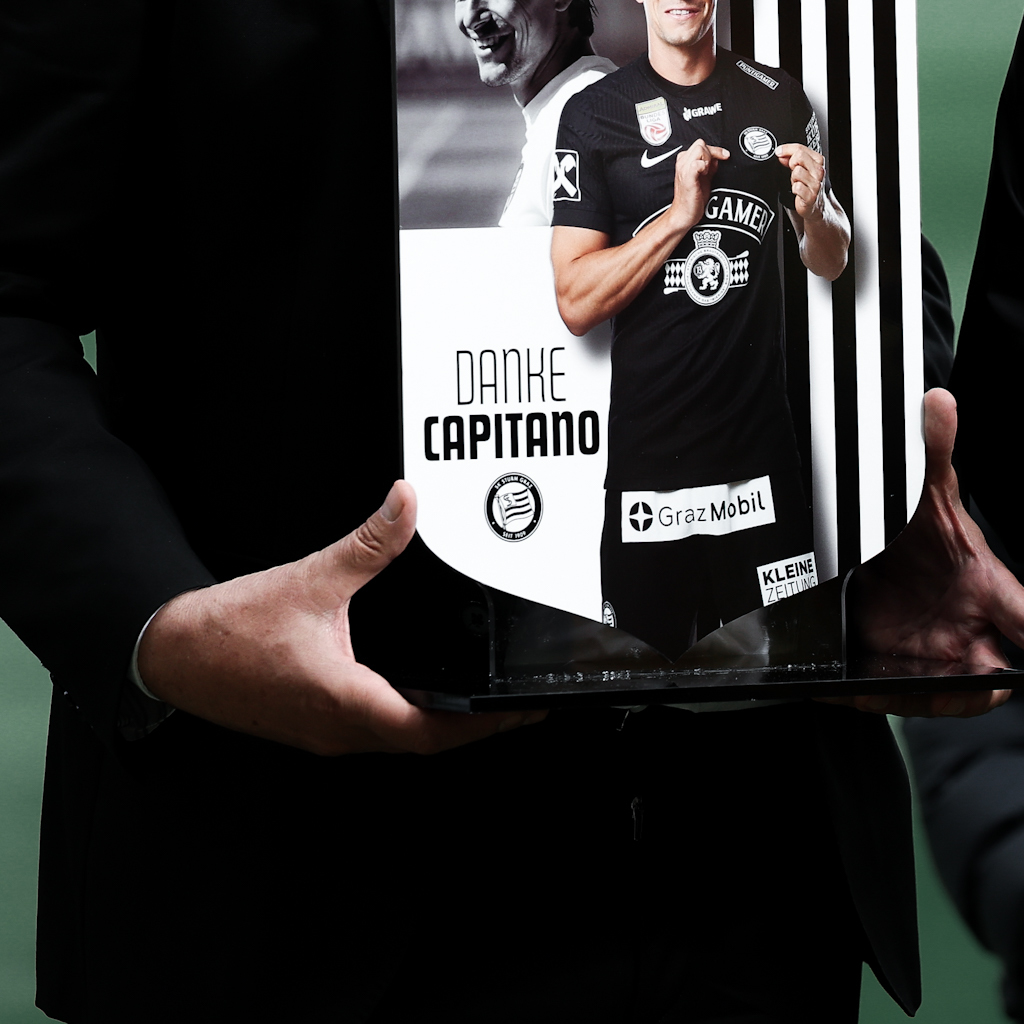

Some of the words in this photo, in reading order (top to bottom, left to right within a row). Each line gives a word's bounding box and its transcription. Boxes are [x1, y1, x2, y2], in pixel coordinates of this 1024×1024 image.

[691, 102, 723, 118] GRAWE
[705, 195, 768, 236] GAMER
[456, 347, 566, 405] DANKE
[424, 410, 600, 461] CAPITANO
[762, 558, 814, 586] KLEINE
[765, 575, 817, 604] ZEITUNG
